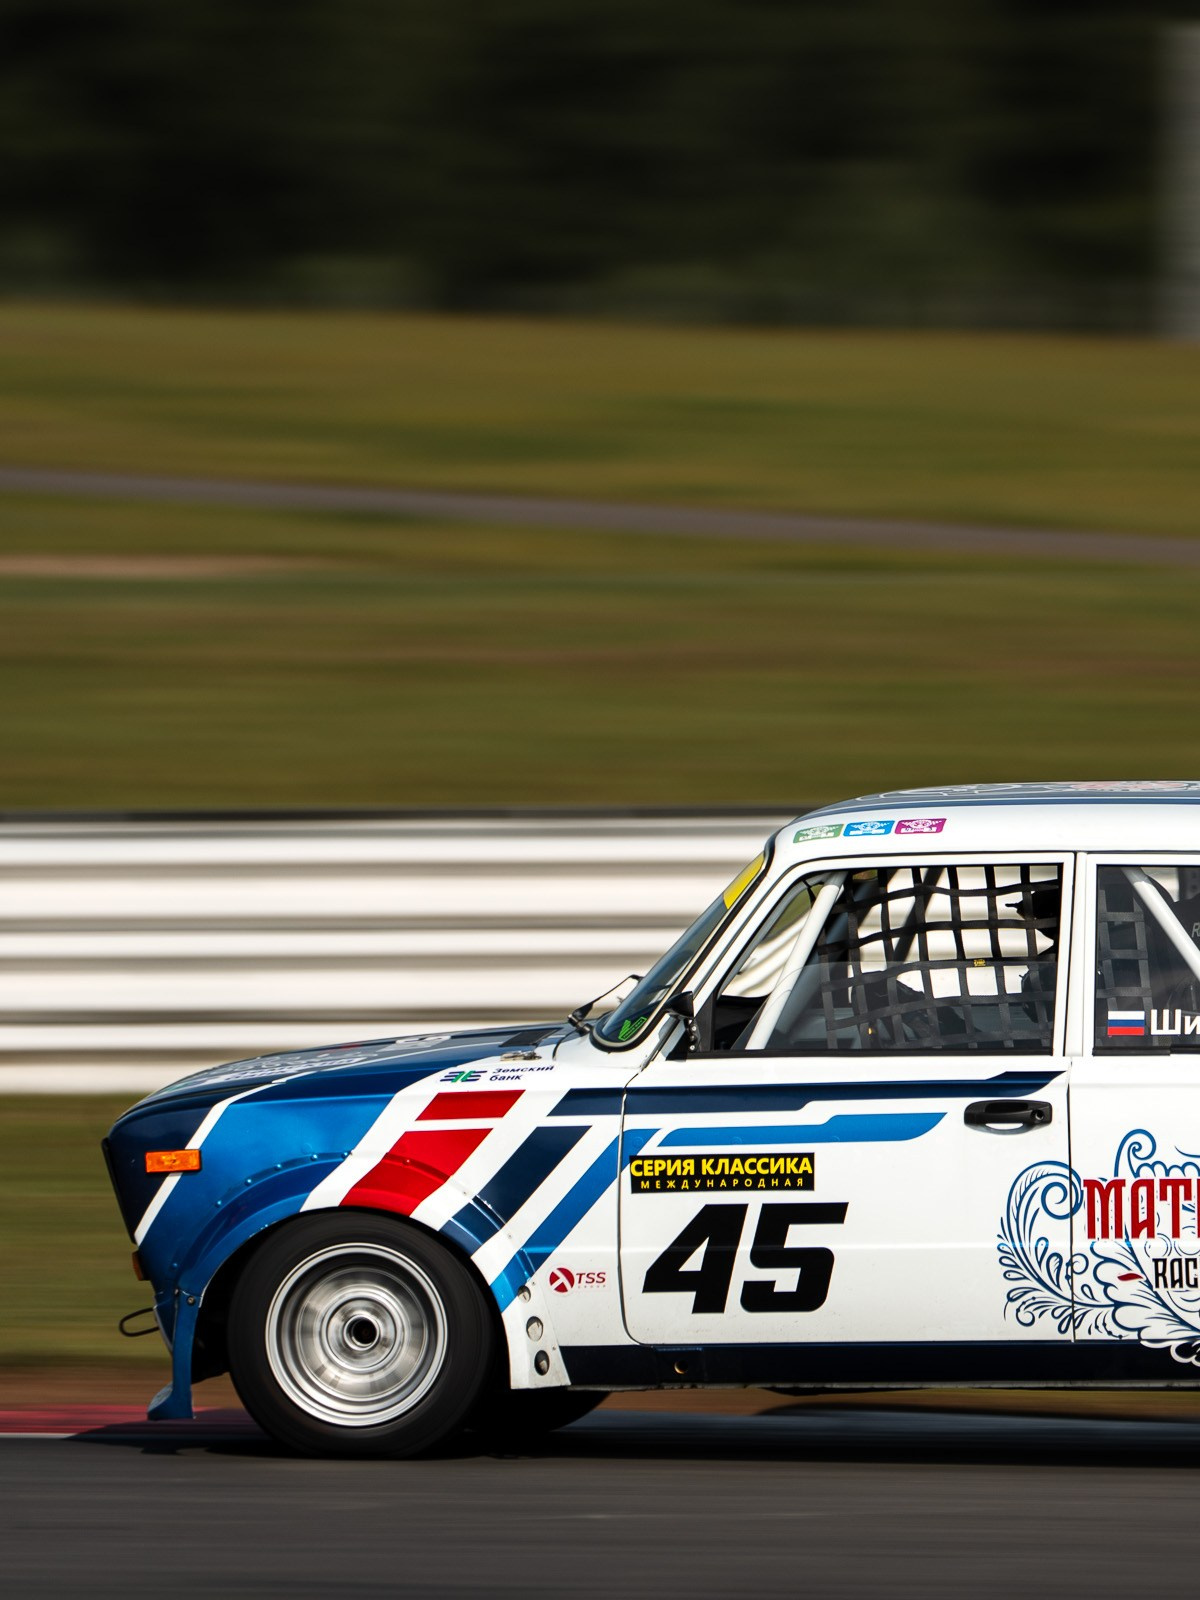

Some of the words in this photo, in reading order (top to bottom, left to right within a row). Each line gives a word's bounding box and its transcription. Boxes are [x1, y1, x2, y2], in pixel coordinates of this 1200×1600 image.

[630, 1158, 695, 1177] СЕРИЯ
[702, 1156, 813, 1175] КЛАССИКА
[640, 1178, 804, 1190] МЕЖДУНАРОДНАЯ
[642, 1202, 849, 1314] 45
[576, 1271, 606, 1284] TSS
